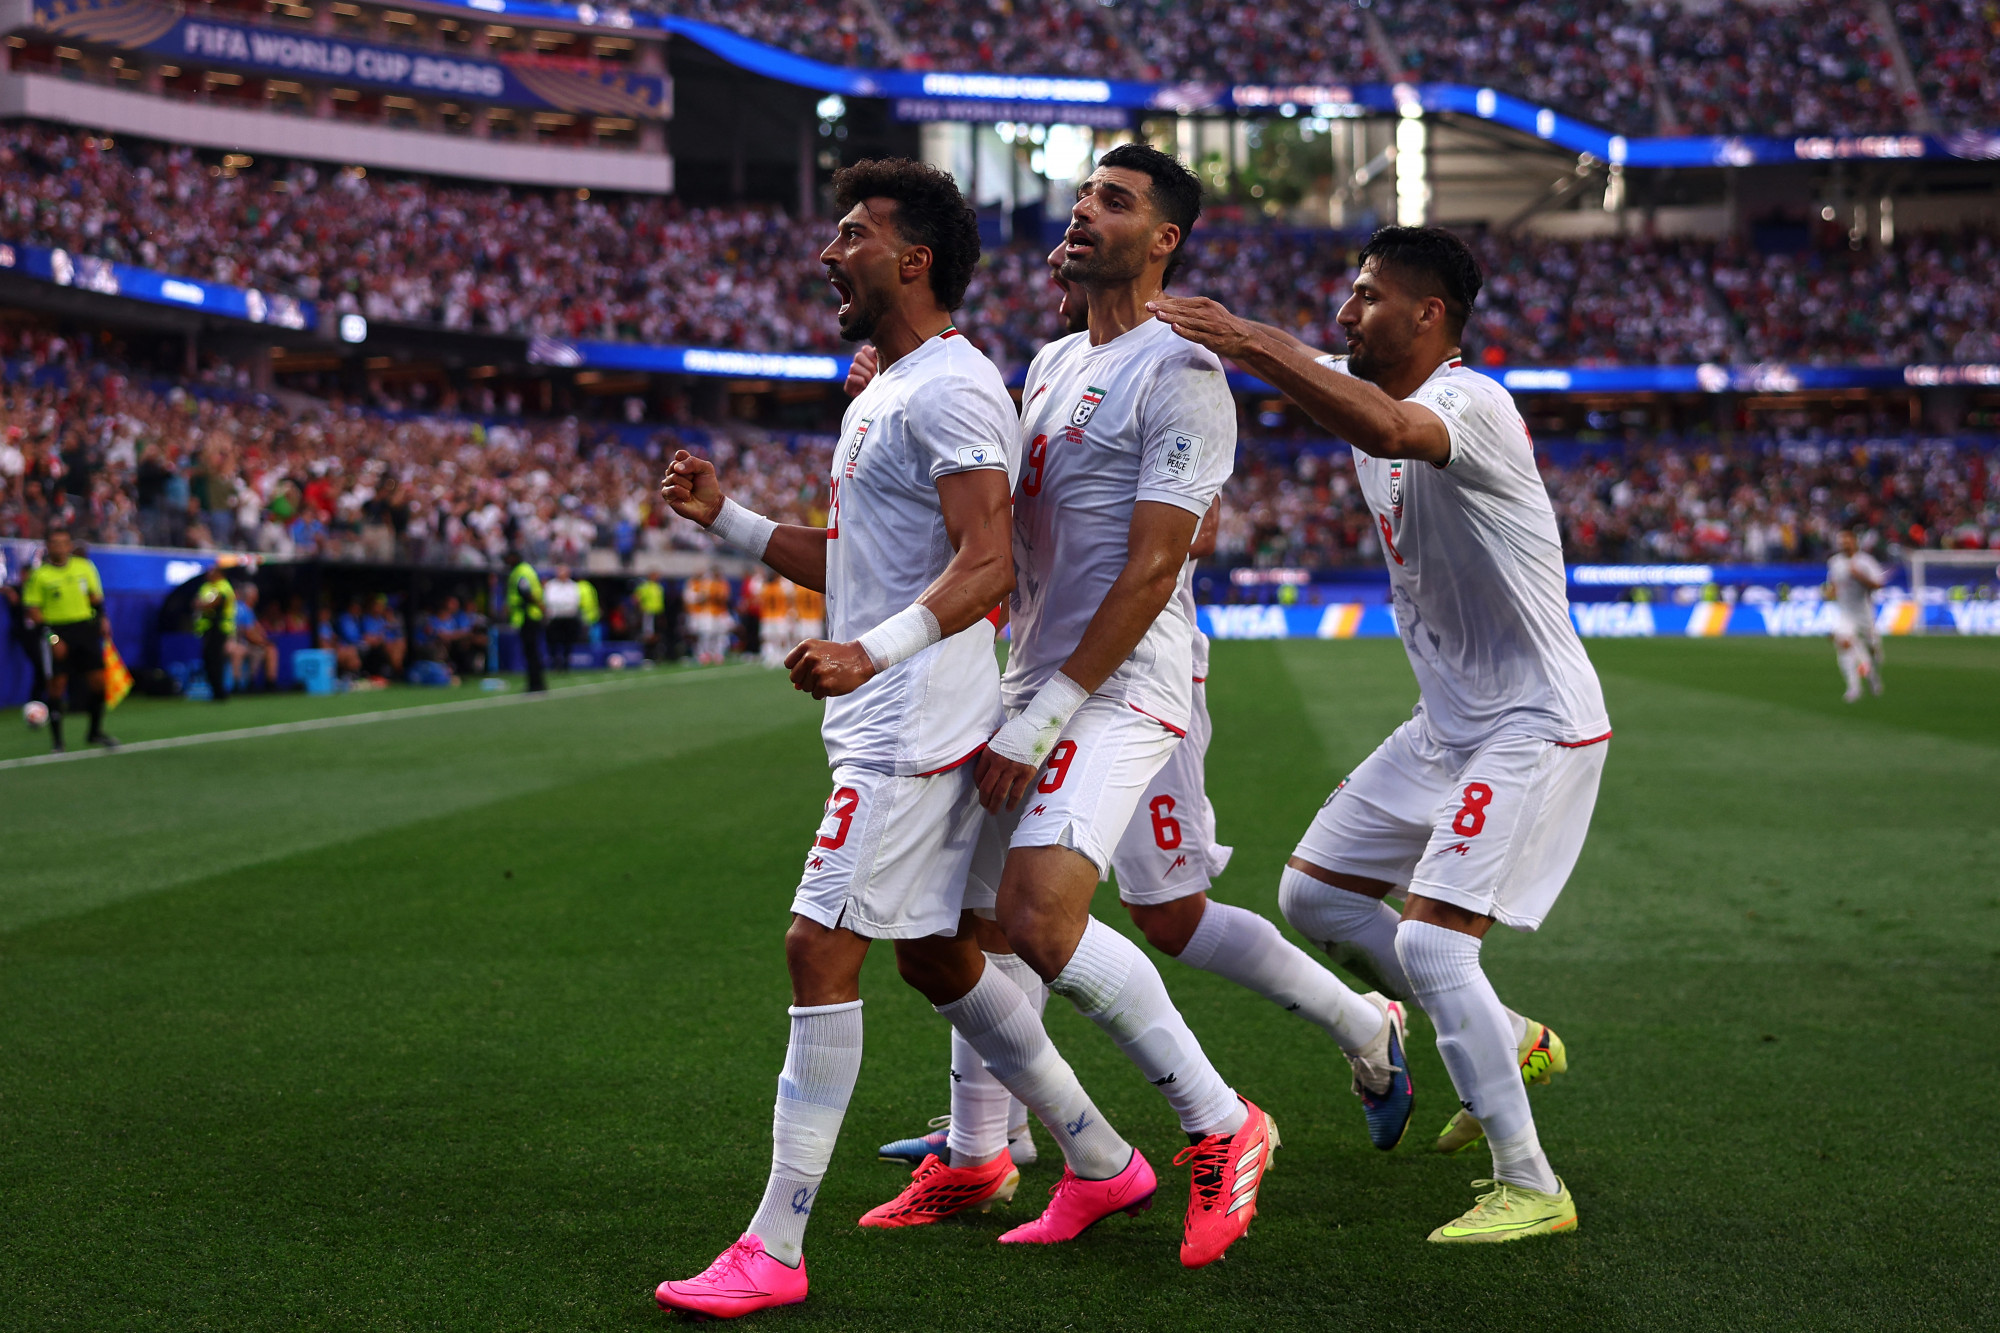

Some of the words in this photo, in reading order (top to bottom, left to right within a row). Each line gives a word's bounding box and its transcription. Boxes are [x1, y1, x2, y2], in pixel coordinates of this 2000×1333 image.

[184, 22, 248, 61] FIFA
[250, 32, 351, 75] WORLD
[355, 48, 411, 82] CUP
[411, 55, 504, 97] 2026
[1022, 433, 1048, 497] 9
[1166, 458, 1188, 471] PEACE
[1379, 513, 1404, 566] 8
[1205, 604, 1289, 639] VISA
[1570, 602, 1656, 637] VISA
[1037, 740, 1078, 794] 9
[1149, 794, 1182, 850] 6
[1452, 782, 1493, 837] 8
